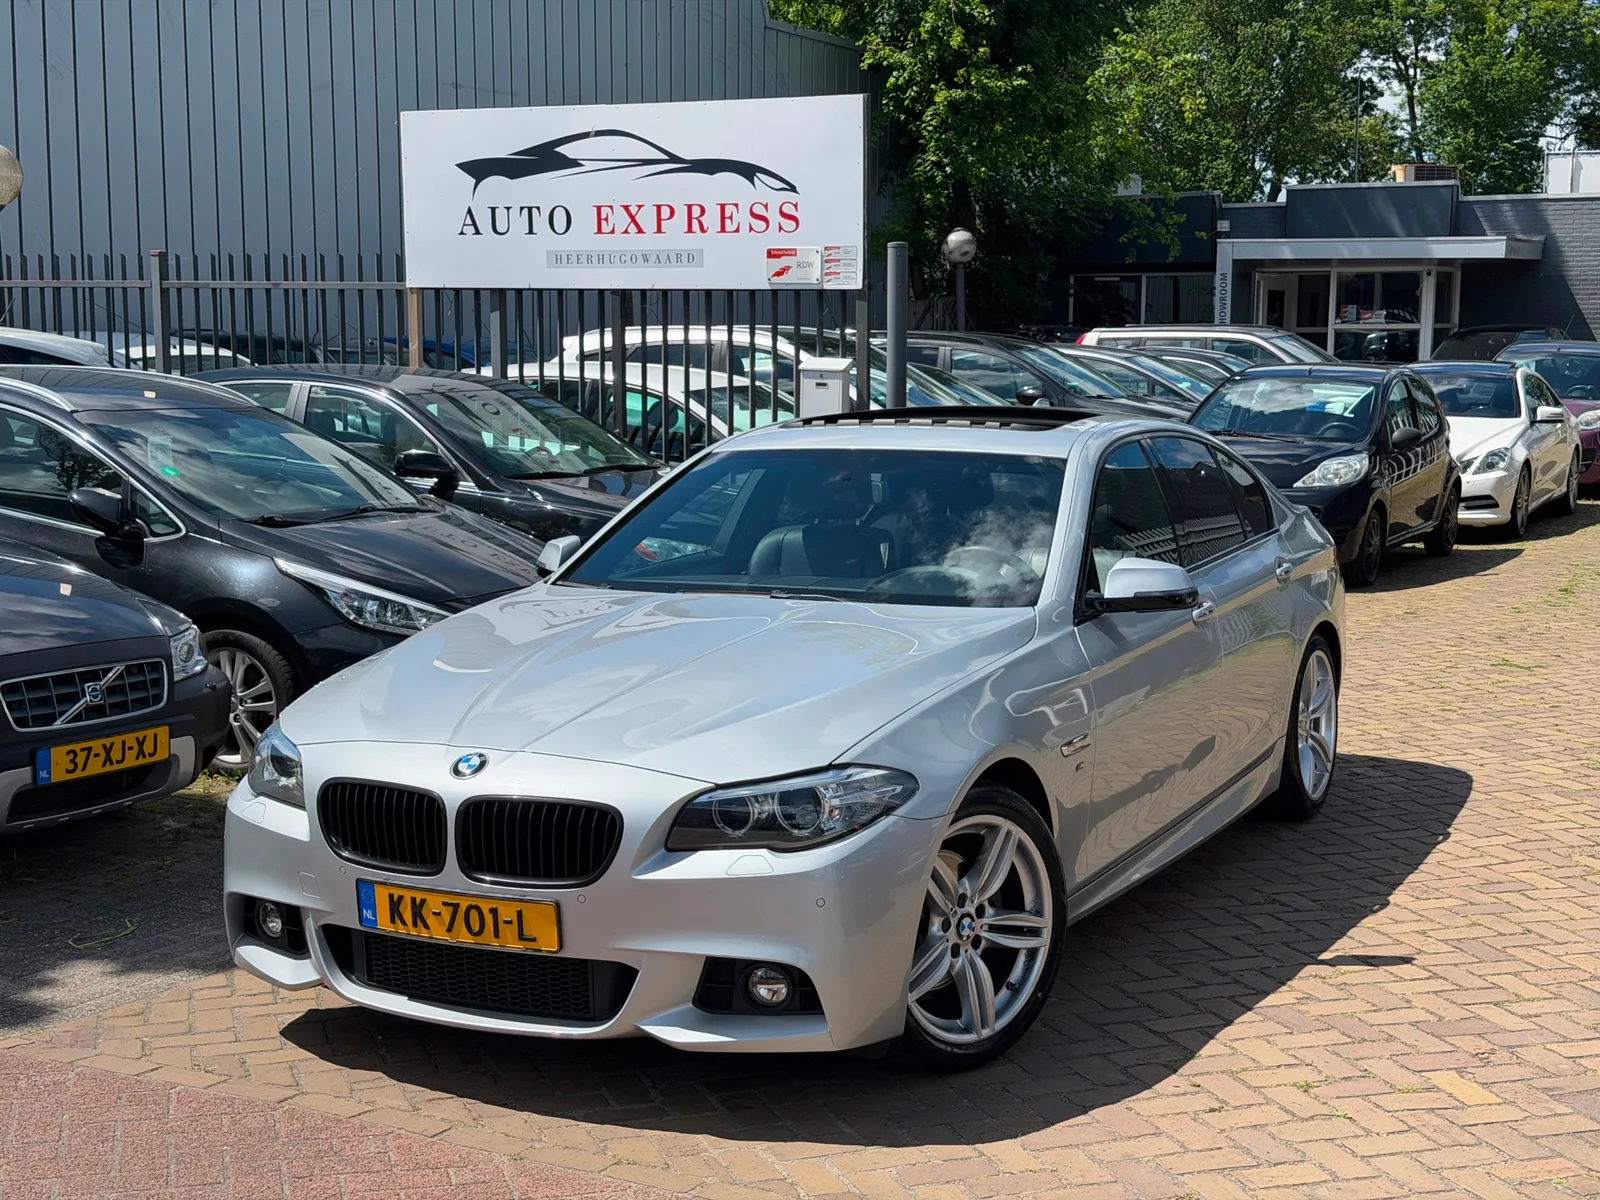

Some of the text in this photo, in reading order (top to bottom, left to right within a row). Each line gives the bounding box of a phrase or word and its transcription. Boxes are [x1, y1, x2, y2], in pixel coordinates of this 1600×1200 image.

[458, 201, 800, 236] AUTO EXPRESS
[555, 252, 695, 265] HEERHUGOWAARD
[1218, 272, 1228, 324] HOWROOM
[65, 732, 158, 774] 37-XJ-XJ
[39, 770, 50, 778] NL
[363, 908, 376, 920] NL
[387, 892, 537, 942] KK-701-L
